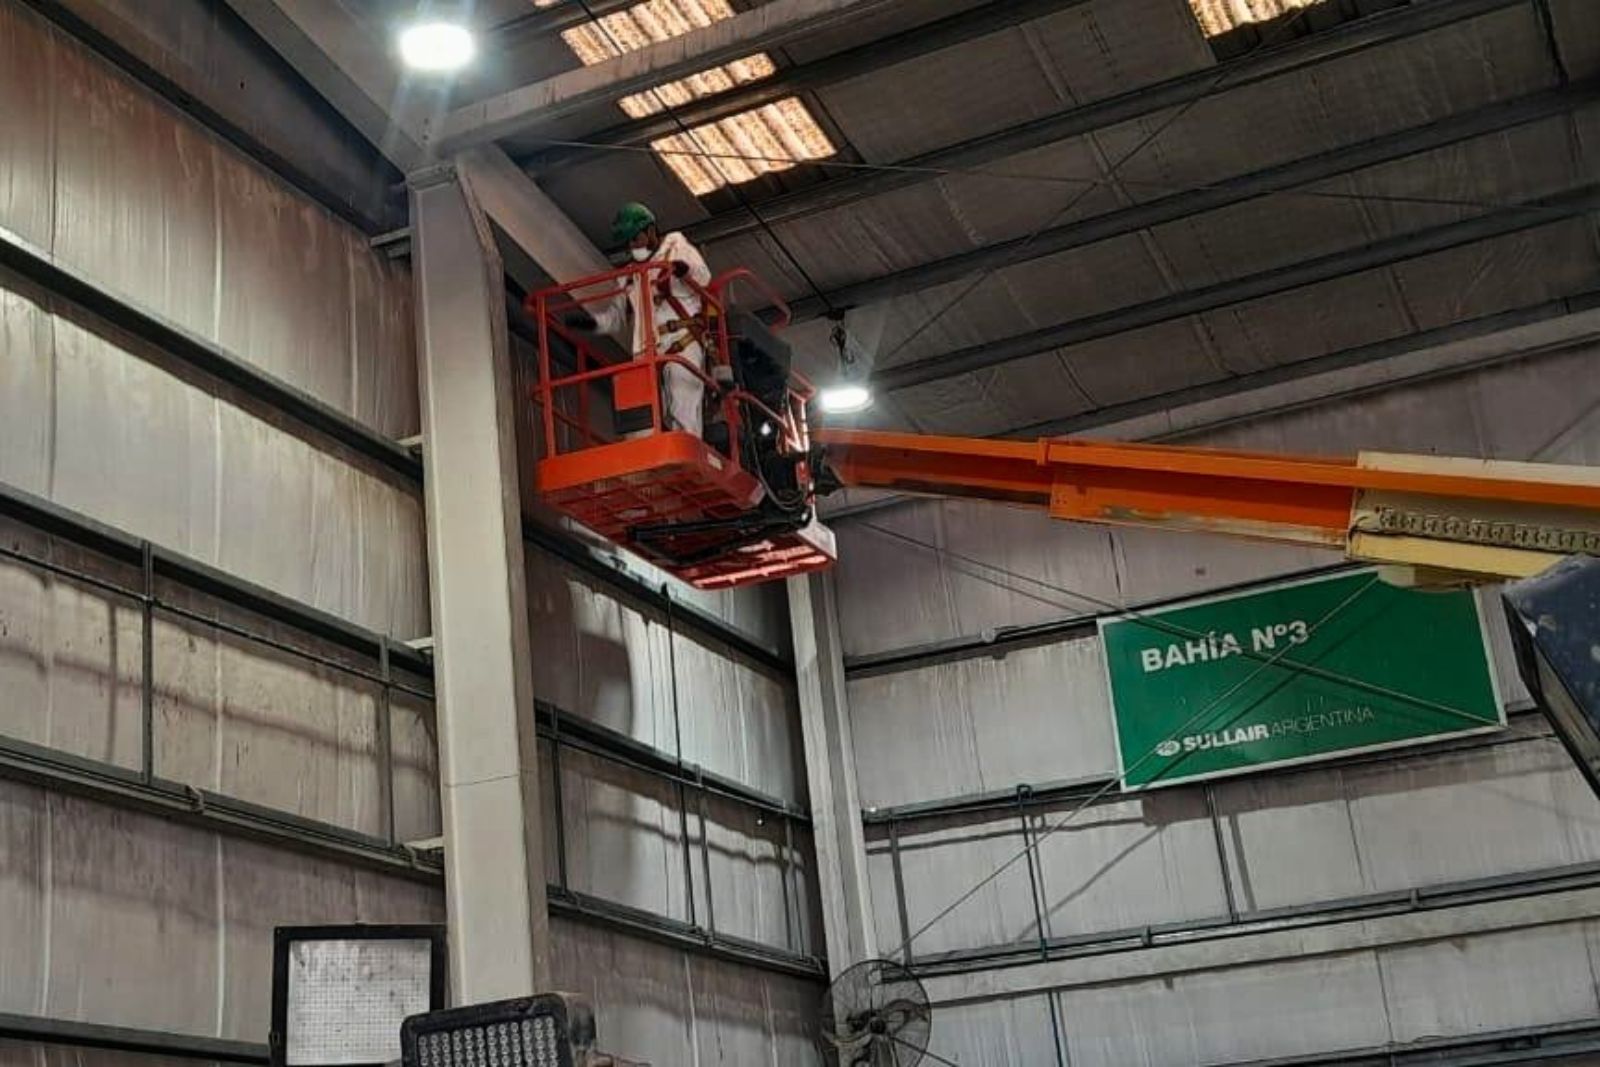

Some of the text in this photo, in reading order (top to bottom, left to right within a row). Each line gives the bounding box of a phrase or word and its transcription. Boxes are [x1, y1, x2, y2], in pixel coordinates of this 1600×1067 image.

[1141, 631, 1243, 672] BAHÍA
[1182, 706, 1375, 752] SULLAIR ARGENTINA
